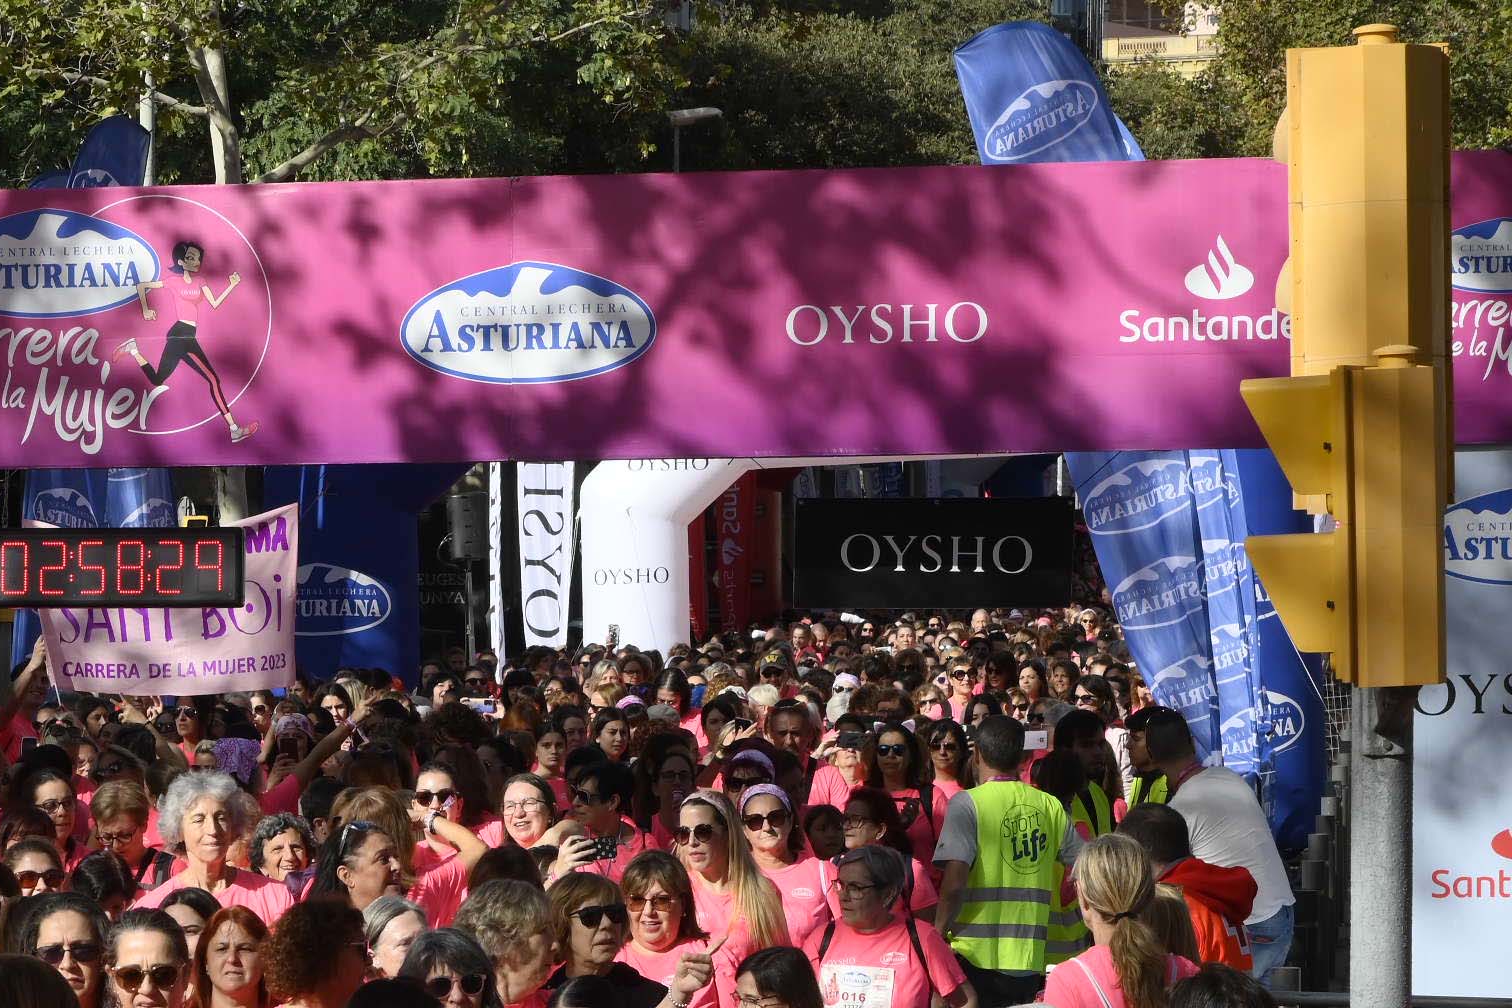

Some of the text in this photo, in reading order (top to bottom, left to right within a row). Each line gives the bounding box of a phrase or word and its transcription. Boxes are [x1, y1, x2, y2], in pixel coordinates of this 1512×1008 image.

[63, 245, 136, 257] LECHERA
[460, 302, 629, 317] CENTRAL LECHERA
[420, 308, 637, 354] ASTURIANA
[786, 301, 988, 347] OYSHO
[1469, 329, 1488, 357] la
[1, 369, 26, 409] la
[20, 360, 170, 455] Mujer
[840, 533, 1033, 574] OYSHO
[0, 540, 223, 595] 02:58:29
[593, 567, 670, 586] OYSHO
[336, 587, 378, 597] LECHERA
[295, 597, 382, 619] TURIANA
[61, 652, 288, 679] CARRERA DE LA MUJER 2023
[1003, 811, 1041, 838] Sport
[1011, 828, 1047, 862] Life
[841, 991, 867, 1003] 016
